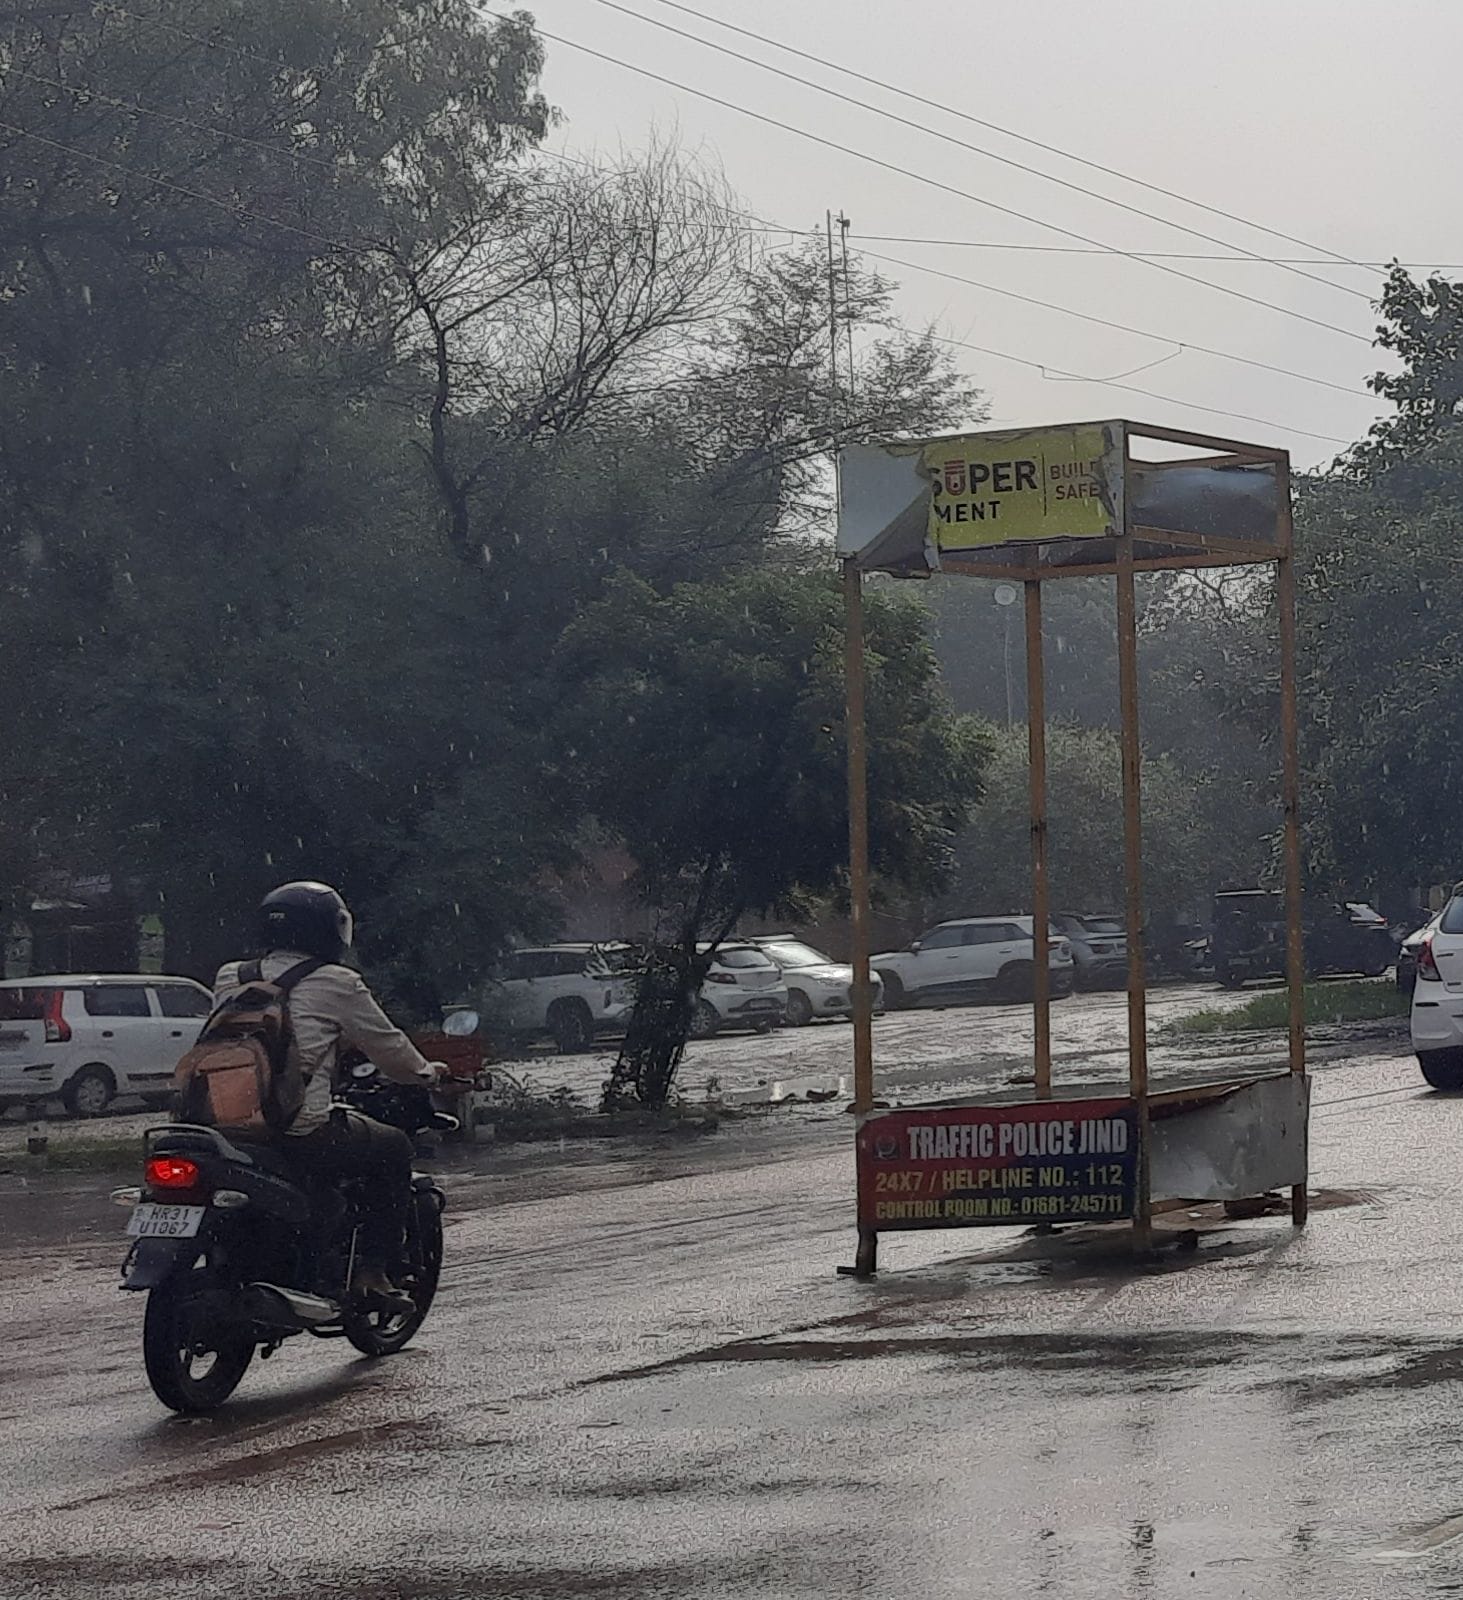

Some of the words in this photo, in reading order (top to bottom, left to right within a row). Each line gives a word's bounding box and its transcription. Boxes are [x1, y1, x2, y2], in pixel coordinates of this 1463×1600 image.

[907, 1123, 994, 1160] TRAFFIC
[999, 1121, 1075, 1157] POLICE
[1078, 1118, 1127, 1154] JIND
[875, 1171, 924, 1192] 24X7
[942, 1167, 1034, 1191] HELPLINE
[1085, 1164, 1123, 1186] 112
[150, 1207, 189, 1221] HR31
[875, 1200, 942, 1219] CONTROL
[944, 1199, 989, 1217] ROOM
